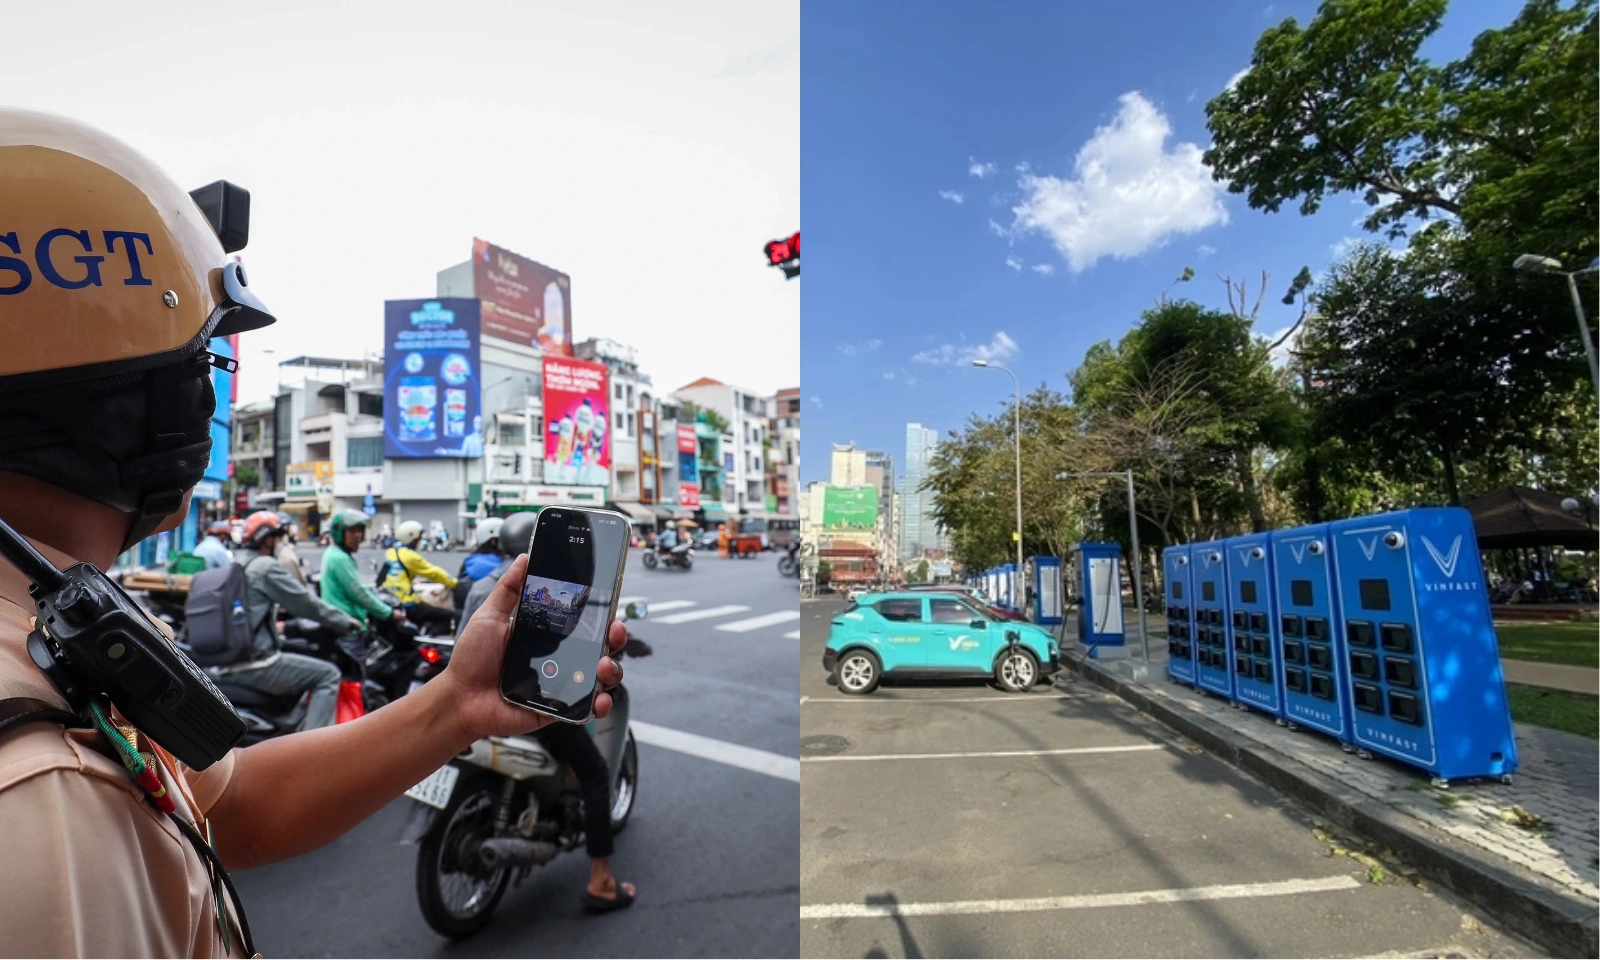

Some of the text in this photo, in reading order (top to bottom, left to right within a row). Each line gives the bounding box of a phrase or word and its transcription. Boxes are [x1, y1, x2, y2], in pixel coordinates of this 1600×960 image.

[568, 536, 585, 544] 2:15
[1425, 581, 1477, 591] VINFAST
[1367, 728, 1418, 751] VINFAST
